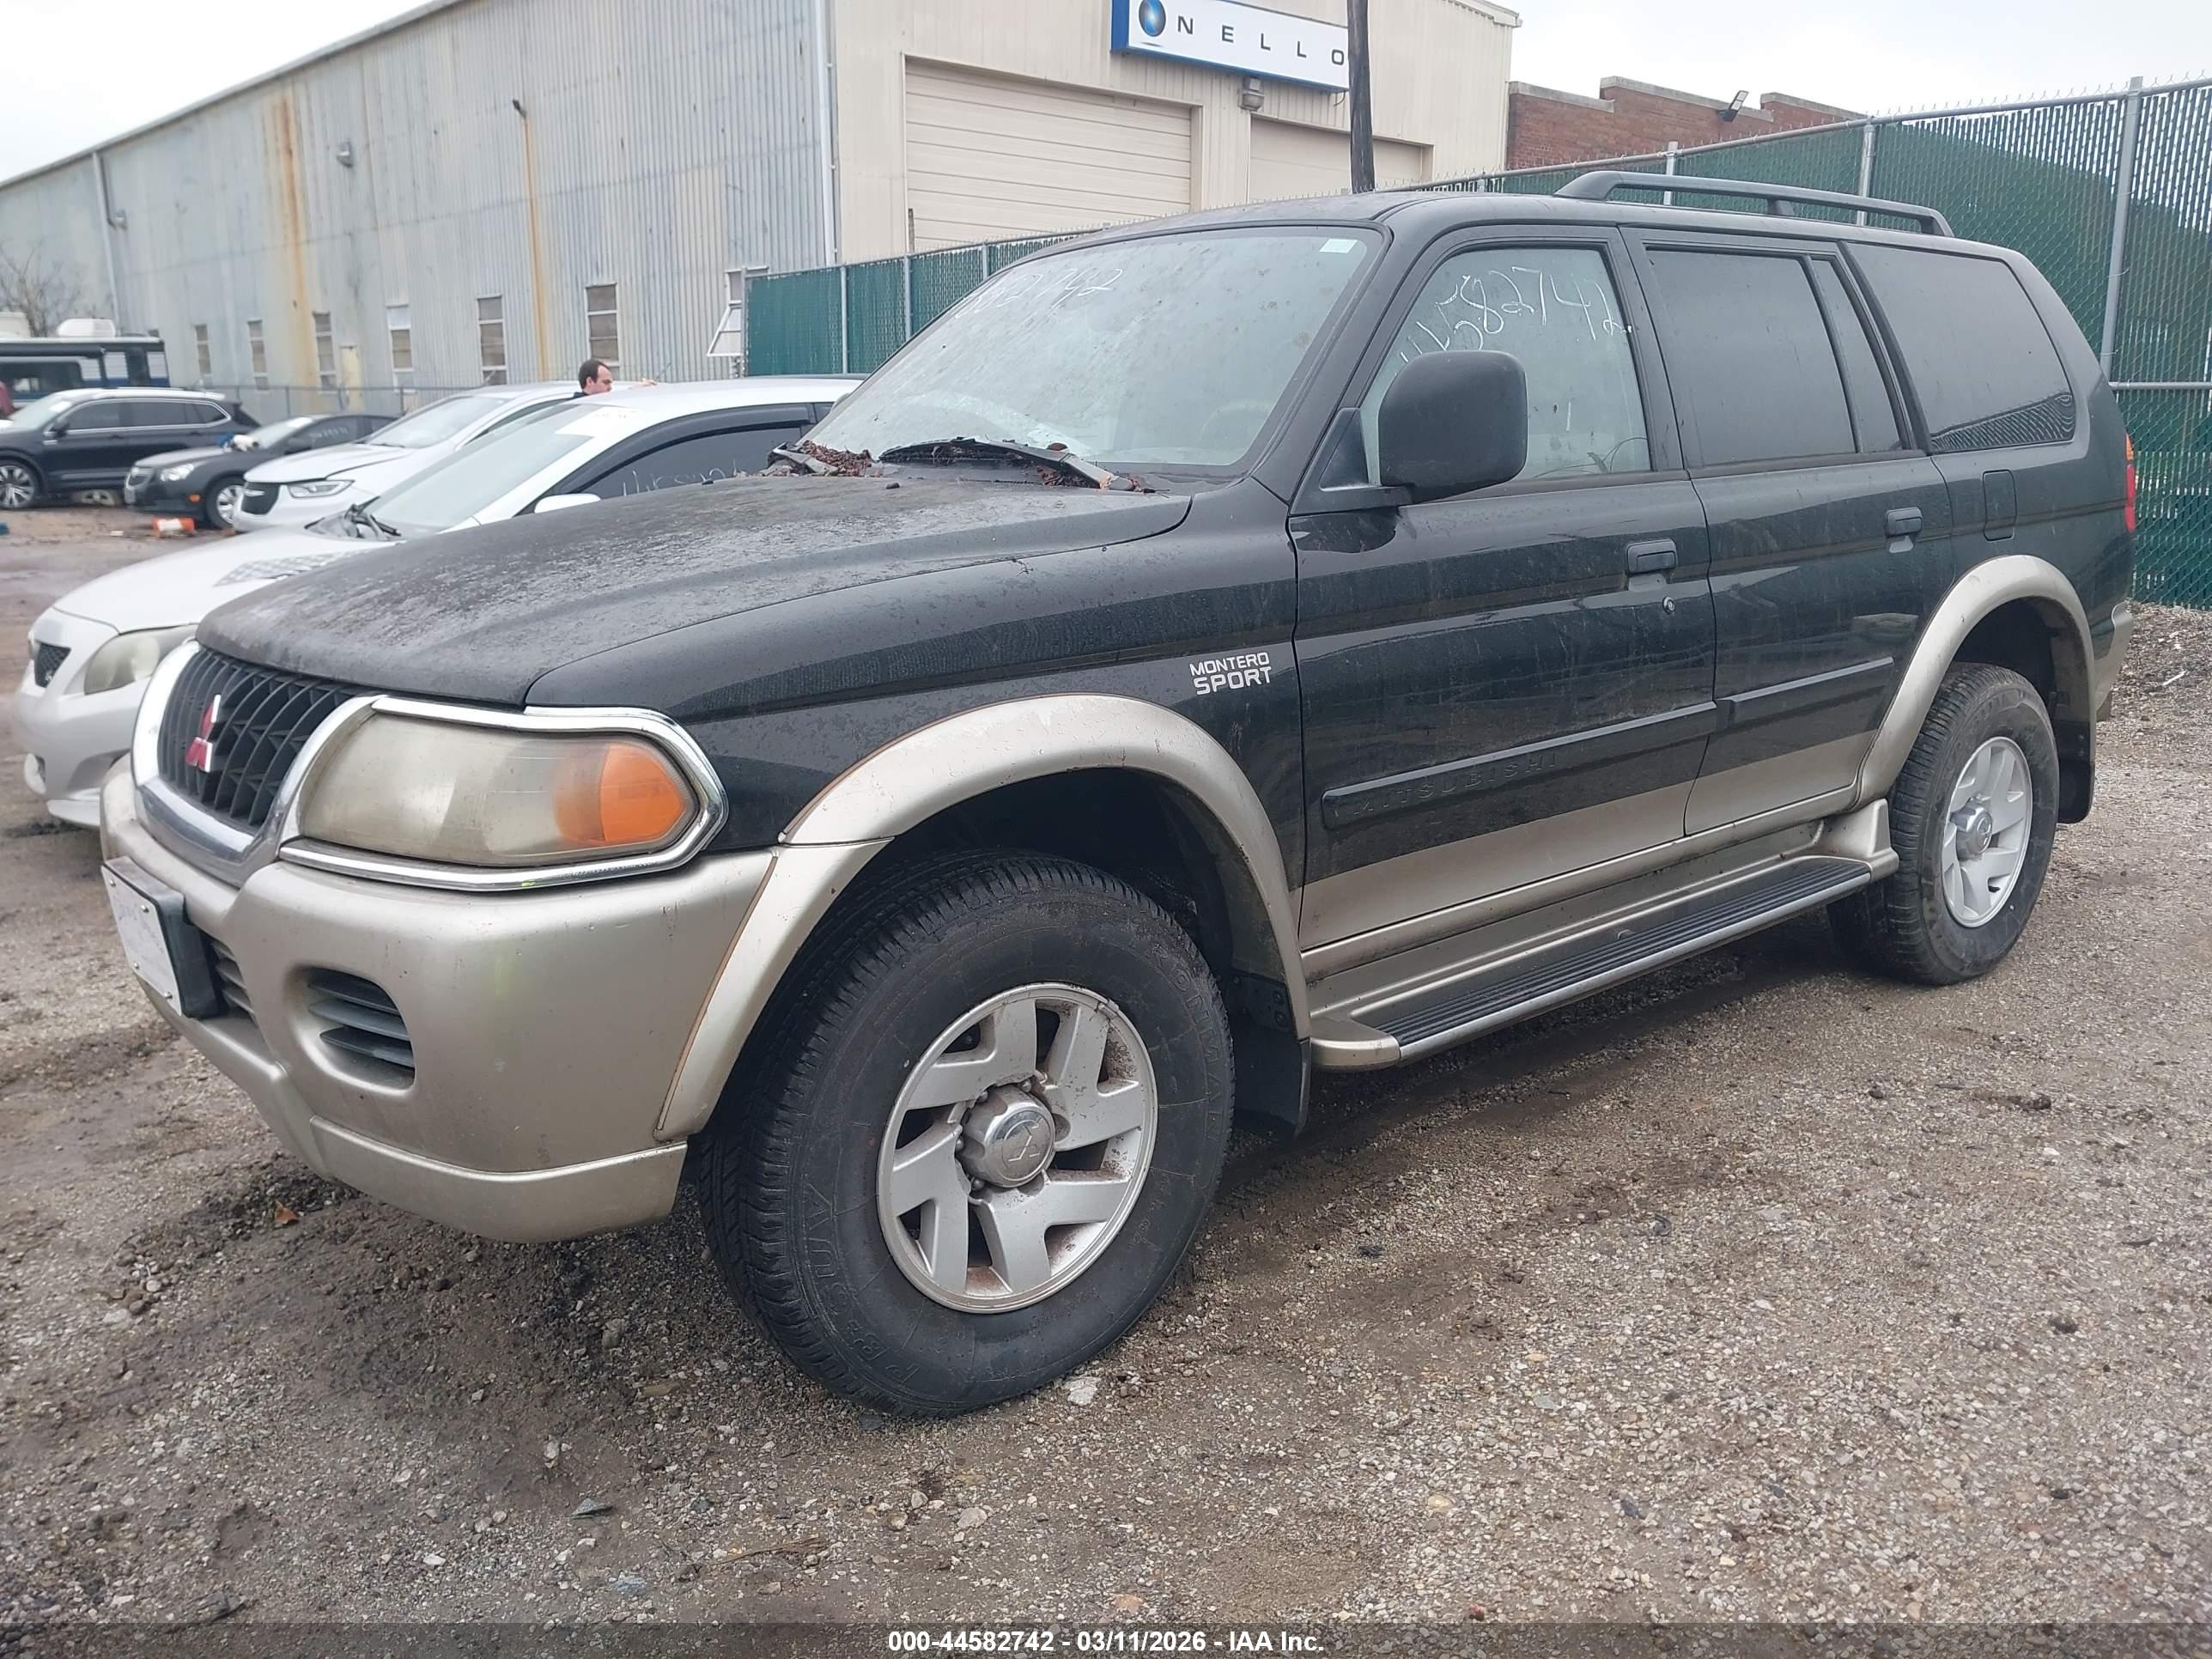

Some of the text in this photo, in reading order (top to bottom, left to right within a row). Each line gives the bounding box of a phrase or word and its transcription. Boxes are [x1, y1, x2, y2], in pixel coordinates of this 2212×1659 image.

[1400, 265, 1632, 363] 582742
[1189, 652, 1270, 676] MONTERO
[1193, 666, 1272, 695] SPORT
